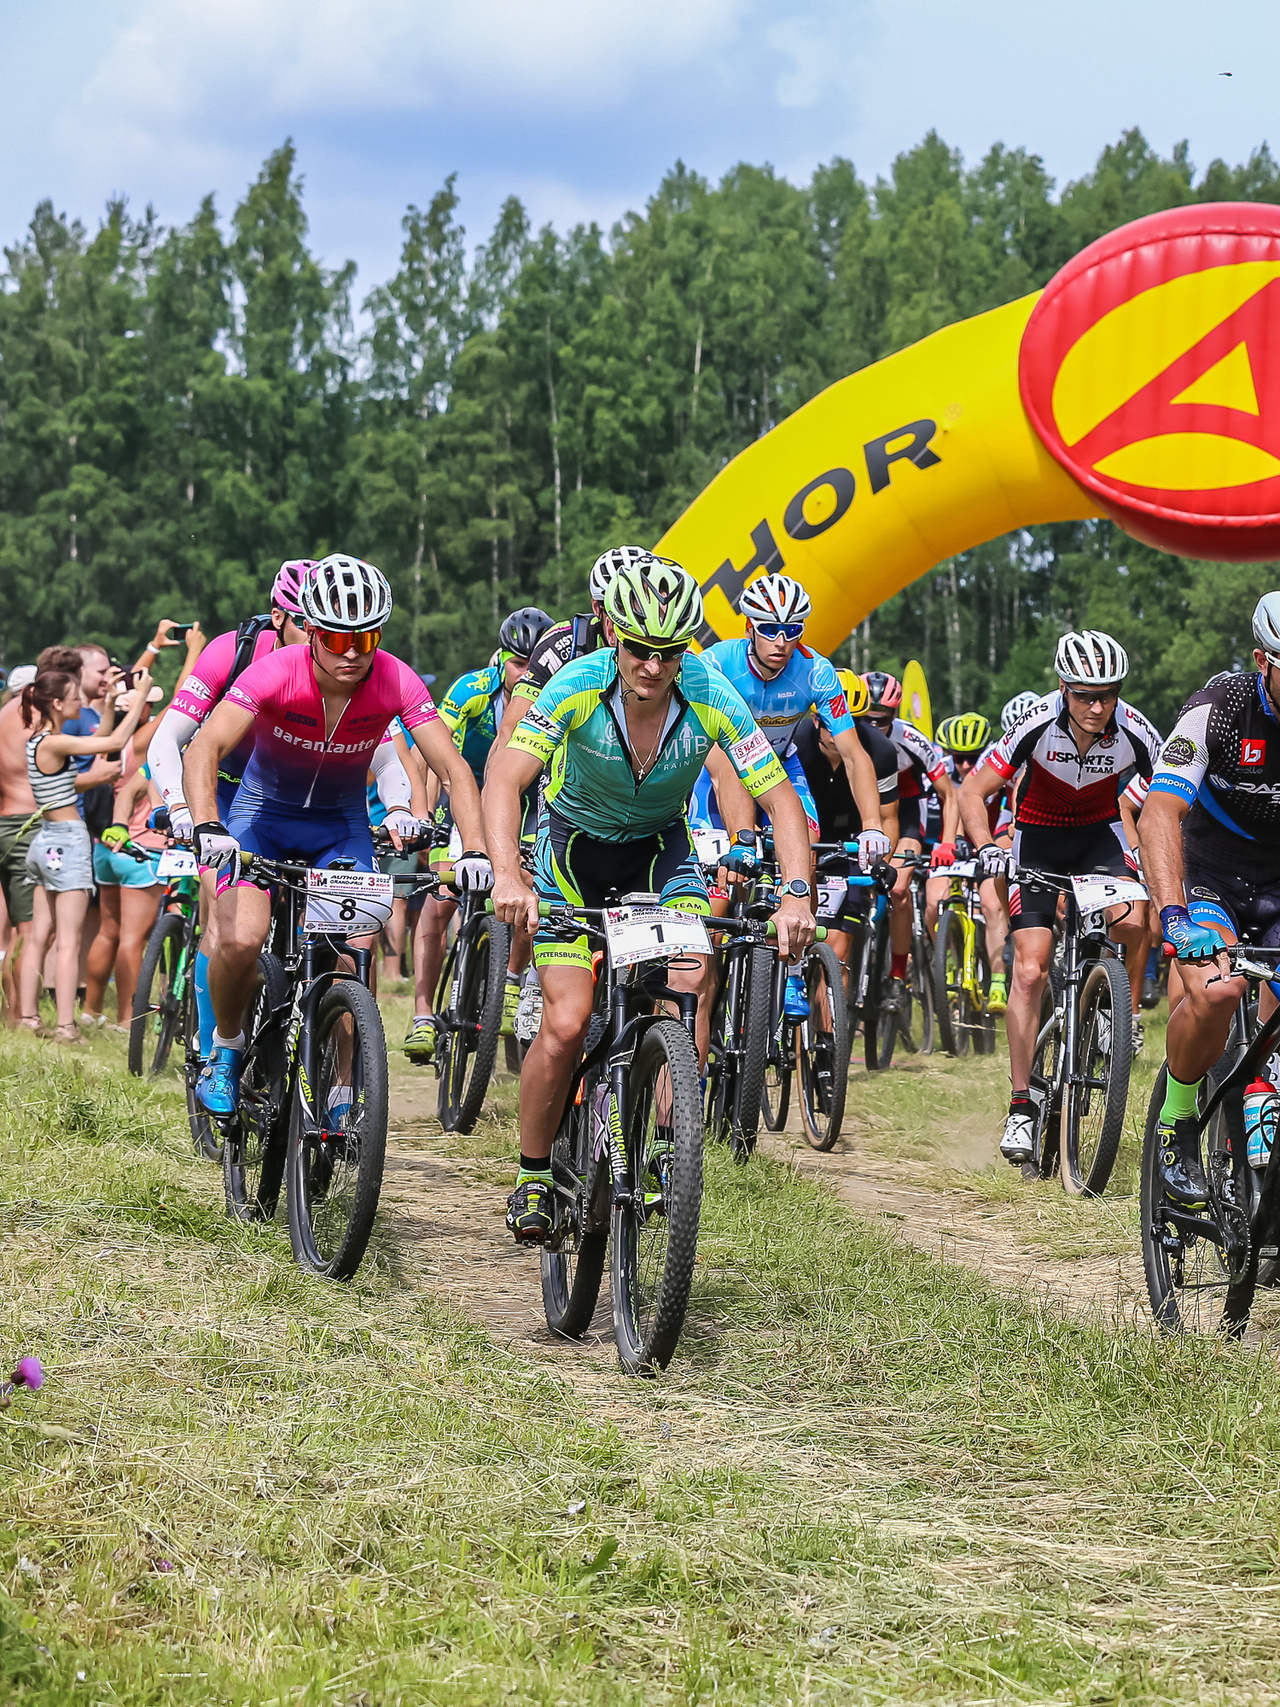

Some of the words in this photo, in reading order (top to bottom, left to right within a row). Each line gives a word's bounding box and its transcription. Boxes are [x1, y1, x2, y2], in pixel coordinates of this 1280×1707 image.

[285, 710, 318, 728] RUSSIA
[1002, 702, 1049, 746] USPORTS
[273, 726, 375, 754] garantauto
[1085, 766, 1113, 774] TEAM
[368, 877, 376, 887] 3
[1104, 884, 1118, 897] 5
[339, 898, 357, 921] 8
[650, 924, 665, 943] 1
